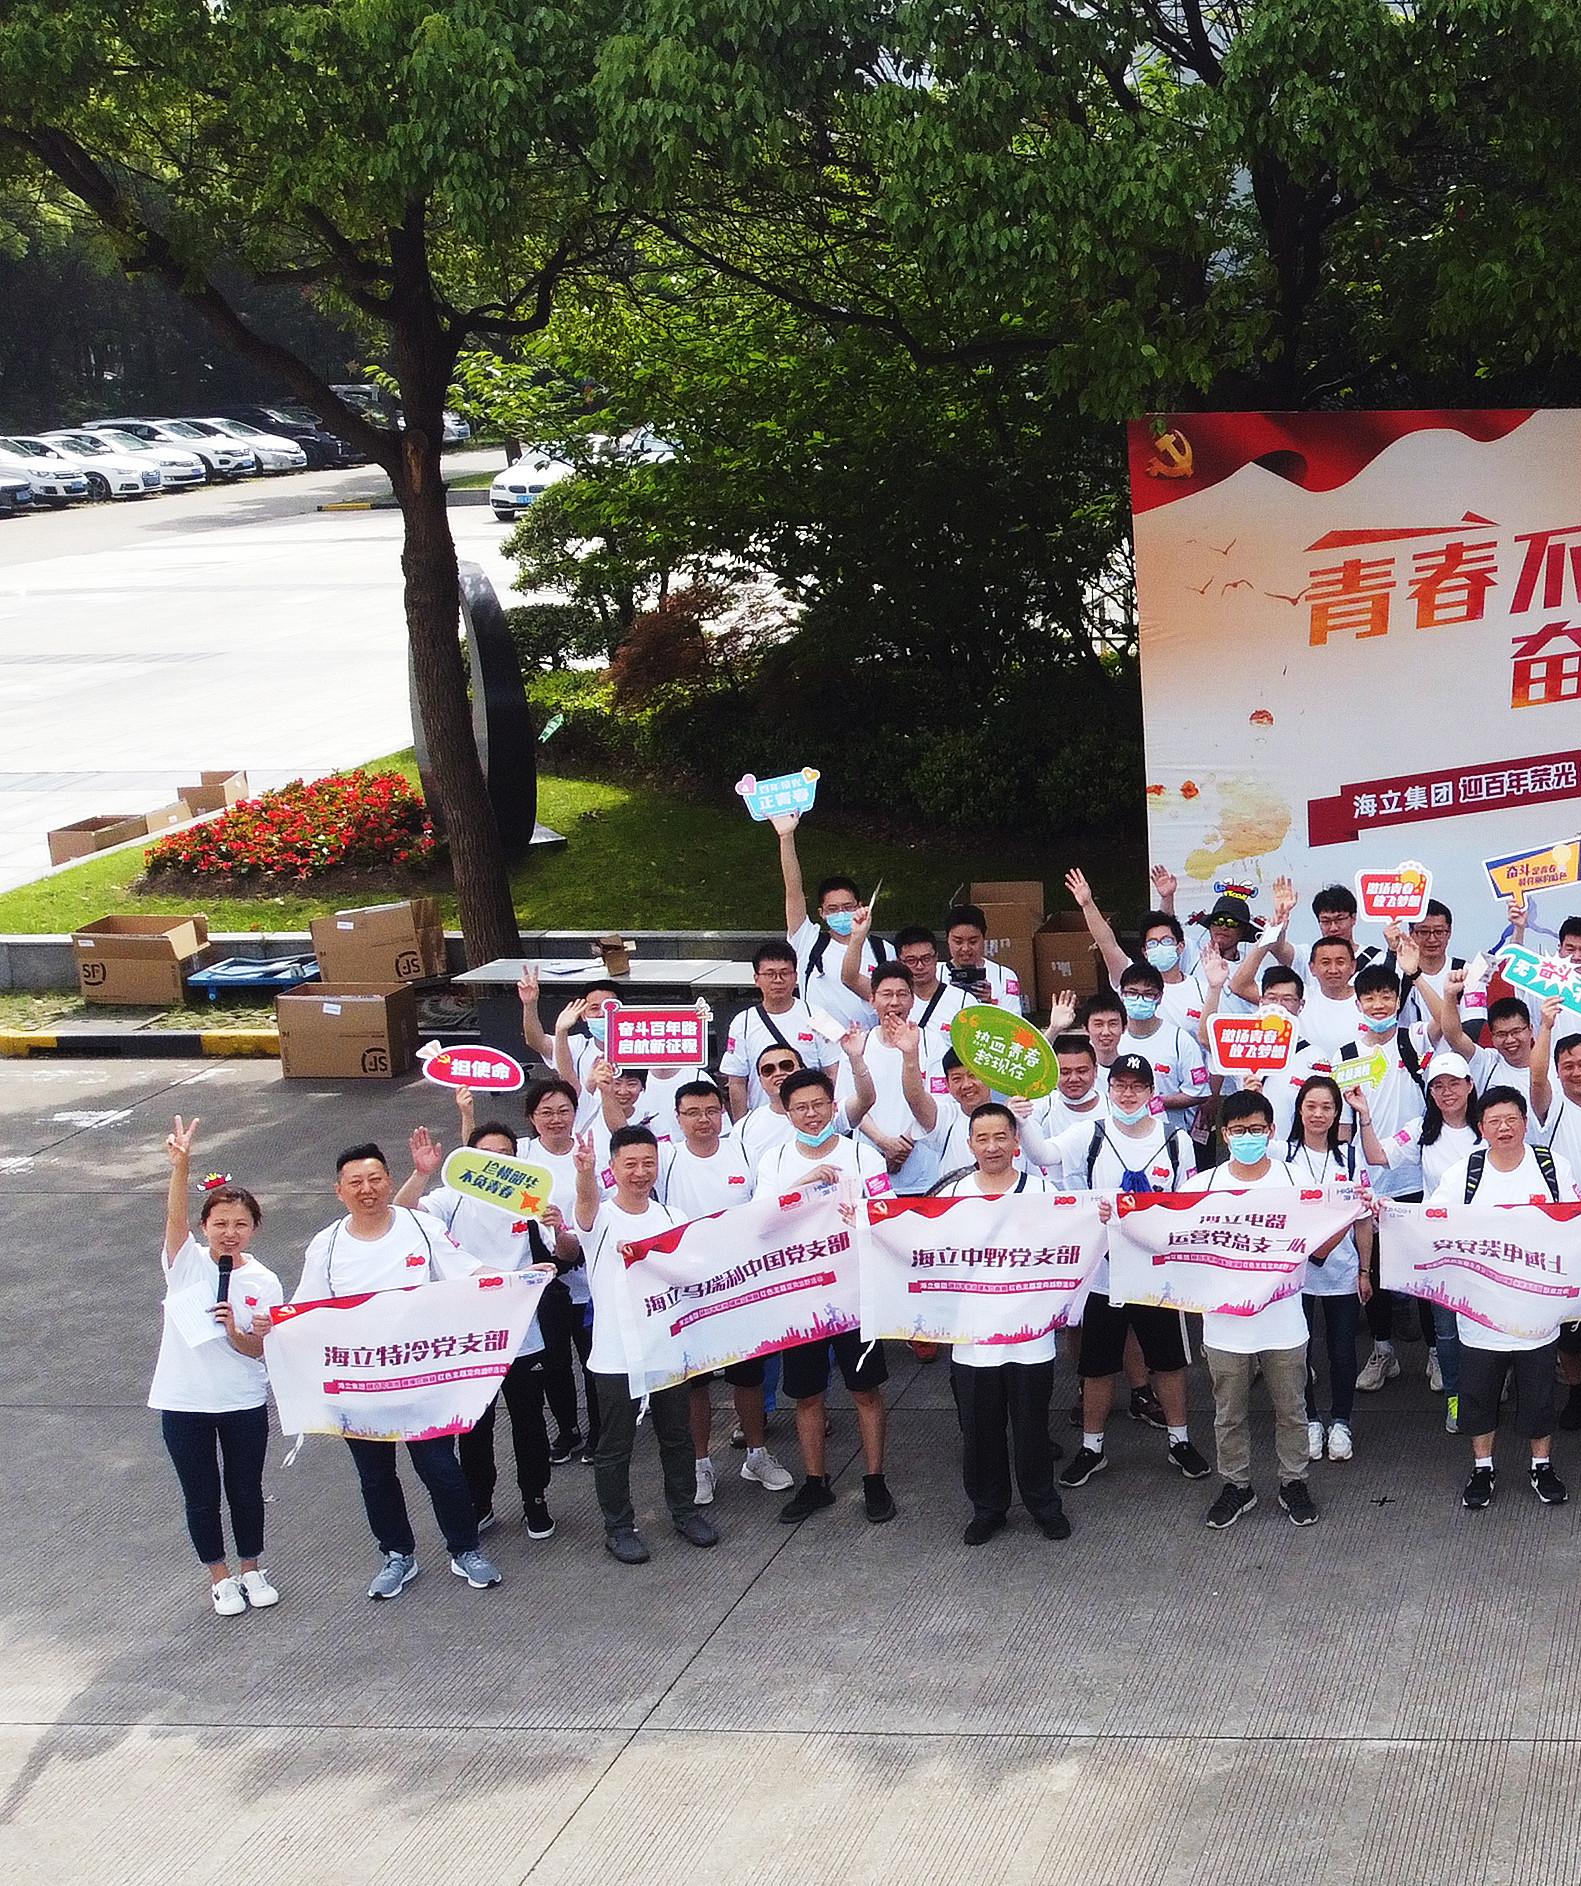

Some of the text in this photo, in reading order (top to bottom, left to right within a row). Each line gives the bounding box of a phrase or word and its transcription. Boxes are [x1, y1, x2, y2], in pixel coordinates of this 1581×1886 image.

[1353, 781, 1453, 819] 海立集团
[1459, 760, 1578, 803] 迎百年荣光
[618, 1021, 698, 1037] 奋斗百年路
[618, 1038, 698, 1055] 启航新征程
[973, 1029, 1041, 1068] 热血青春
[1229, 1043, 1287, 1059] 放飞梦想
[451, 1058, 511, 1081] 担使命
[973, 1049, 1026, 1080] 趁现在
[459, 1168, 515, 1199] 不负青春
[482, 1160, 539, 1189] 珍惜韶华
[911, 1245, 1081, 1268] 海立中野党支部
[644, 1231, 850, 1317] 海立马瑞利中国党支部
[324, 1329, 509, 1368] 海立特冷党支部
